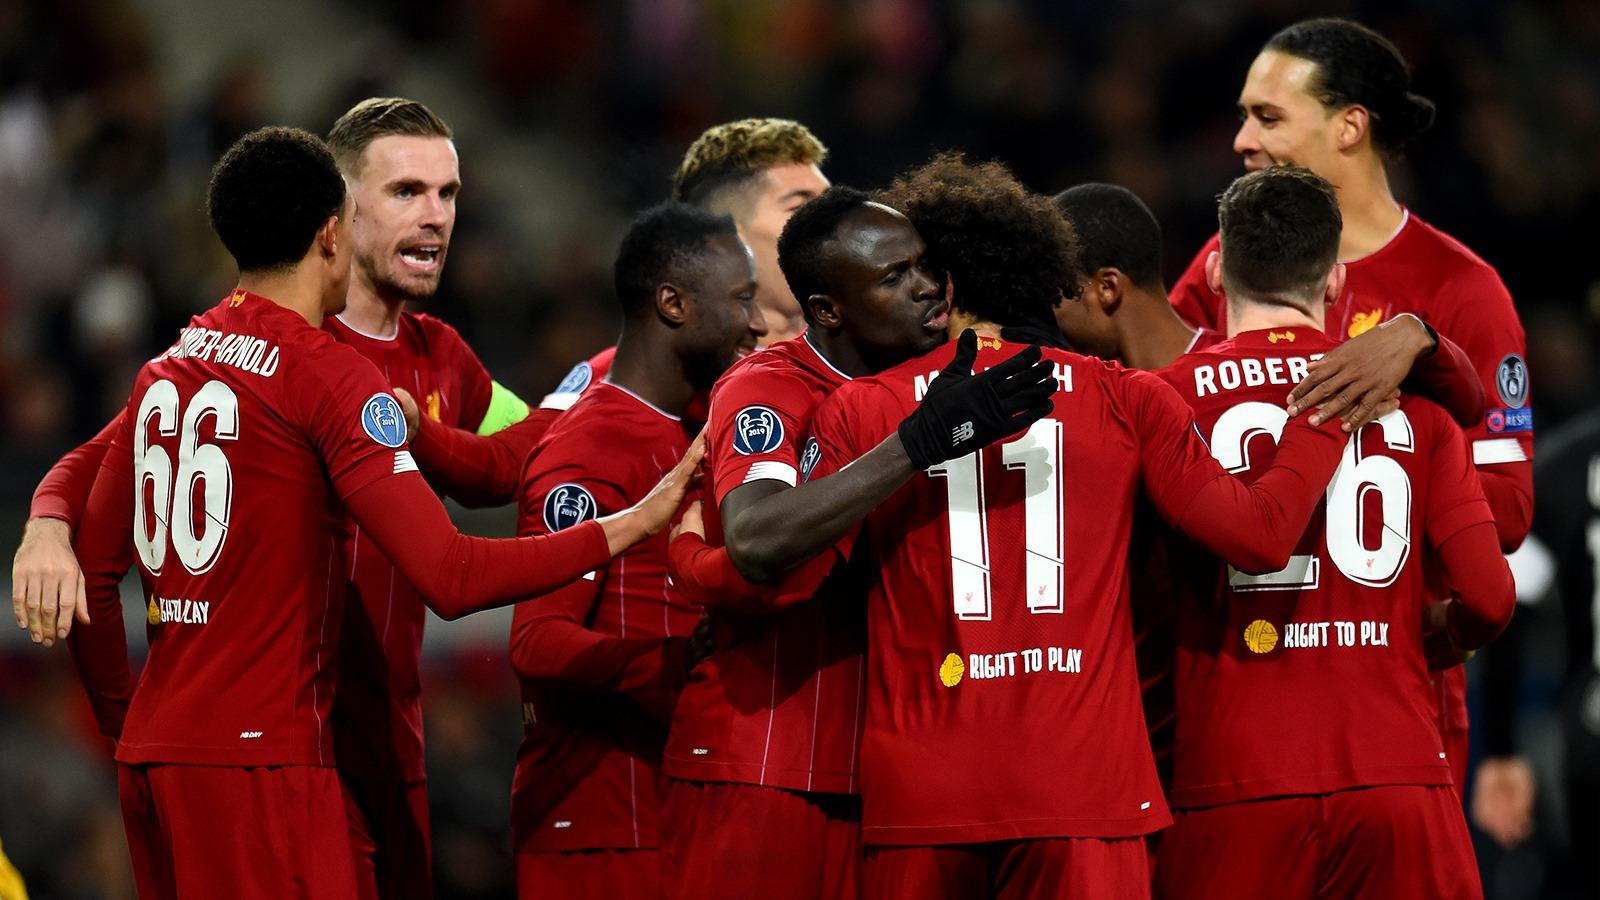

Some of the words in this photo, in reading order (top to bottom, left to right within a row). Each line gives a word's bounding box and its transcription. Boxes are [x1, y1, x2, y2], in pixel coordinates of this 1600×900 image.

[748, 428, 766, 437] 2019
[134, 379, 239, 576] 66
[561, 508, 578, 518] 2019
[1211, 401, 1415, 592] 26
[924, 418, 1064, 621] 11
[1284, 622, 1330, 648] RIGHT
[1334, 621, 1356, 647] TO
[969, 652, 1018, 679] RIGHT
[1021, 648, 1043, 673] TO
[1048, 646, 1082, 673] PLAY
